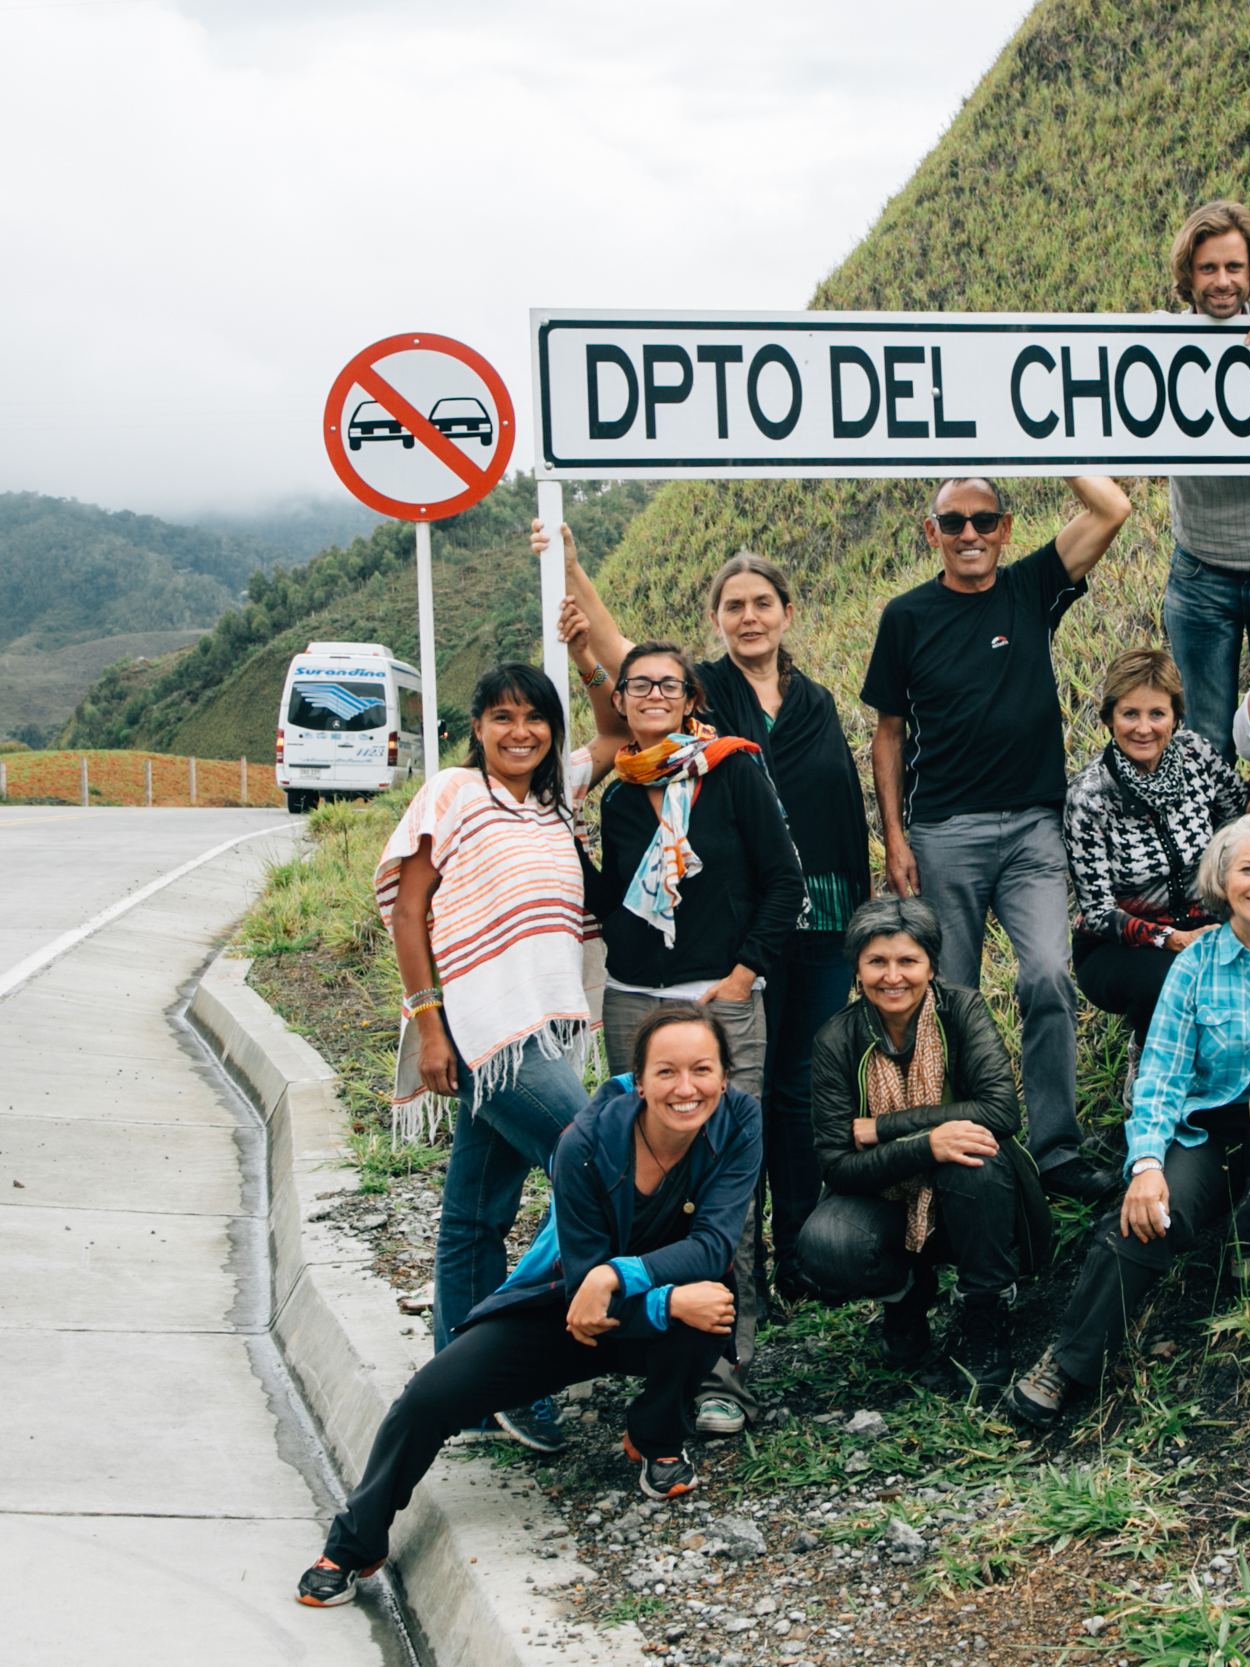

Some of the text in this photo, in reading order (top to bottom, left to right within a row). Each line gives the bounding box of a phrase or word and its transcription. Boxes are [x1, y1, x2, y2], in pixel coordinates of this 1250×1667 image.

[586, 344, 802, 440] DPTO
[830, 346, 977, 439] DEL
[294, 667, 386, 677] Surandina
[356, 748, 385, 757] 1123
